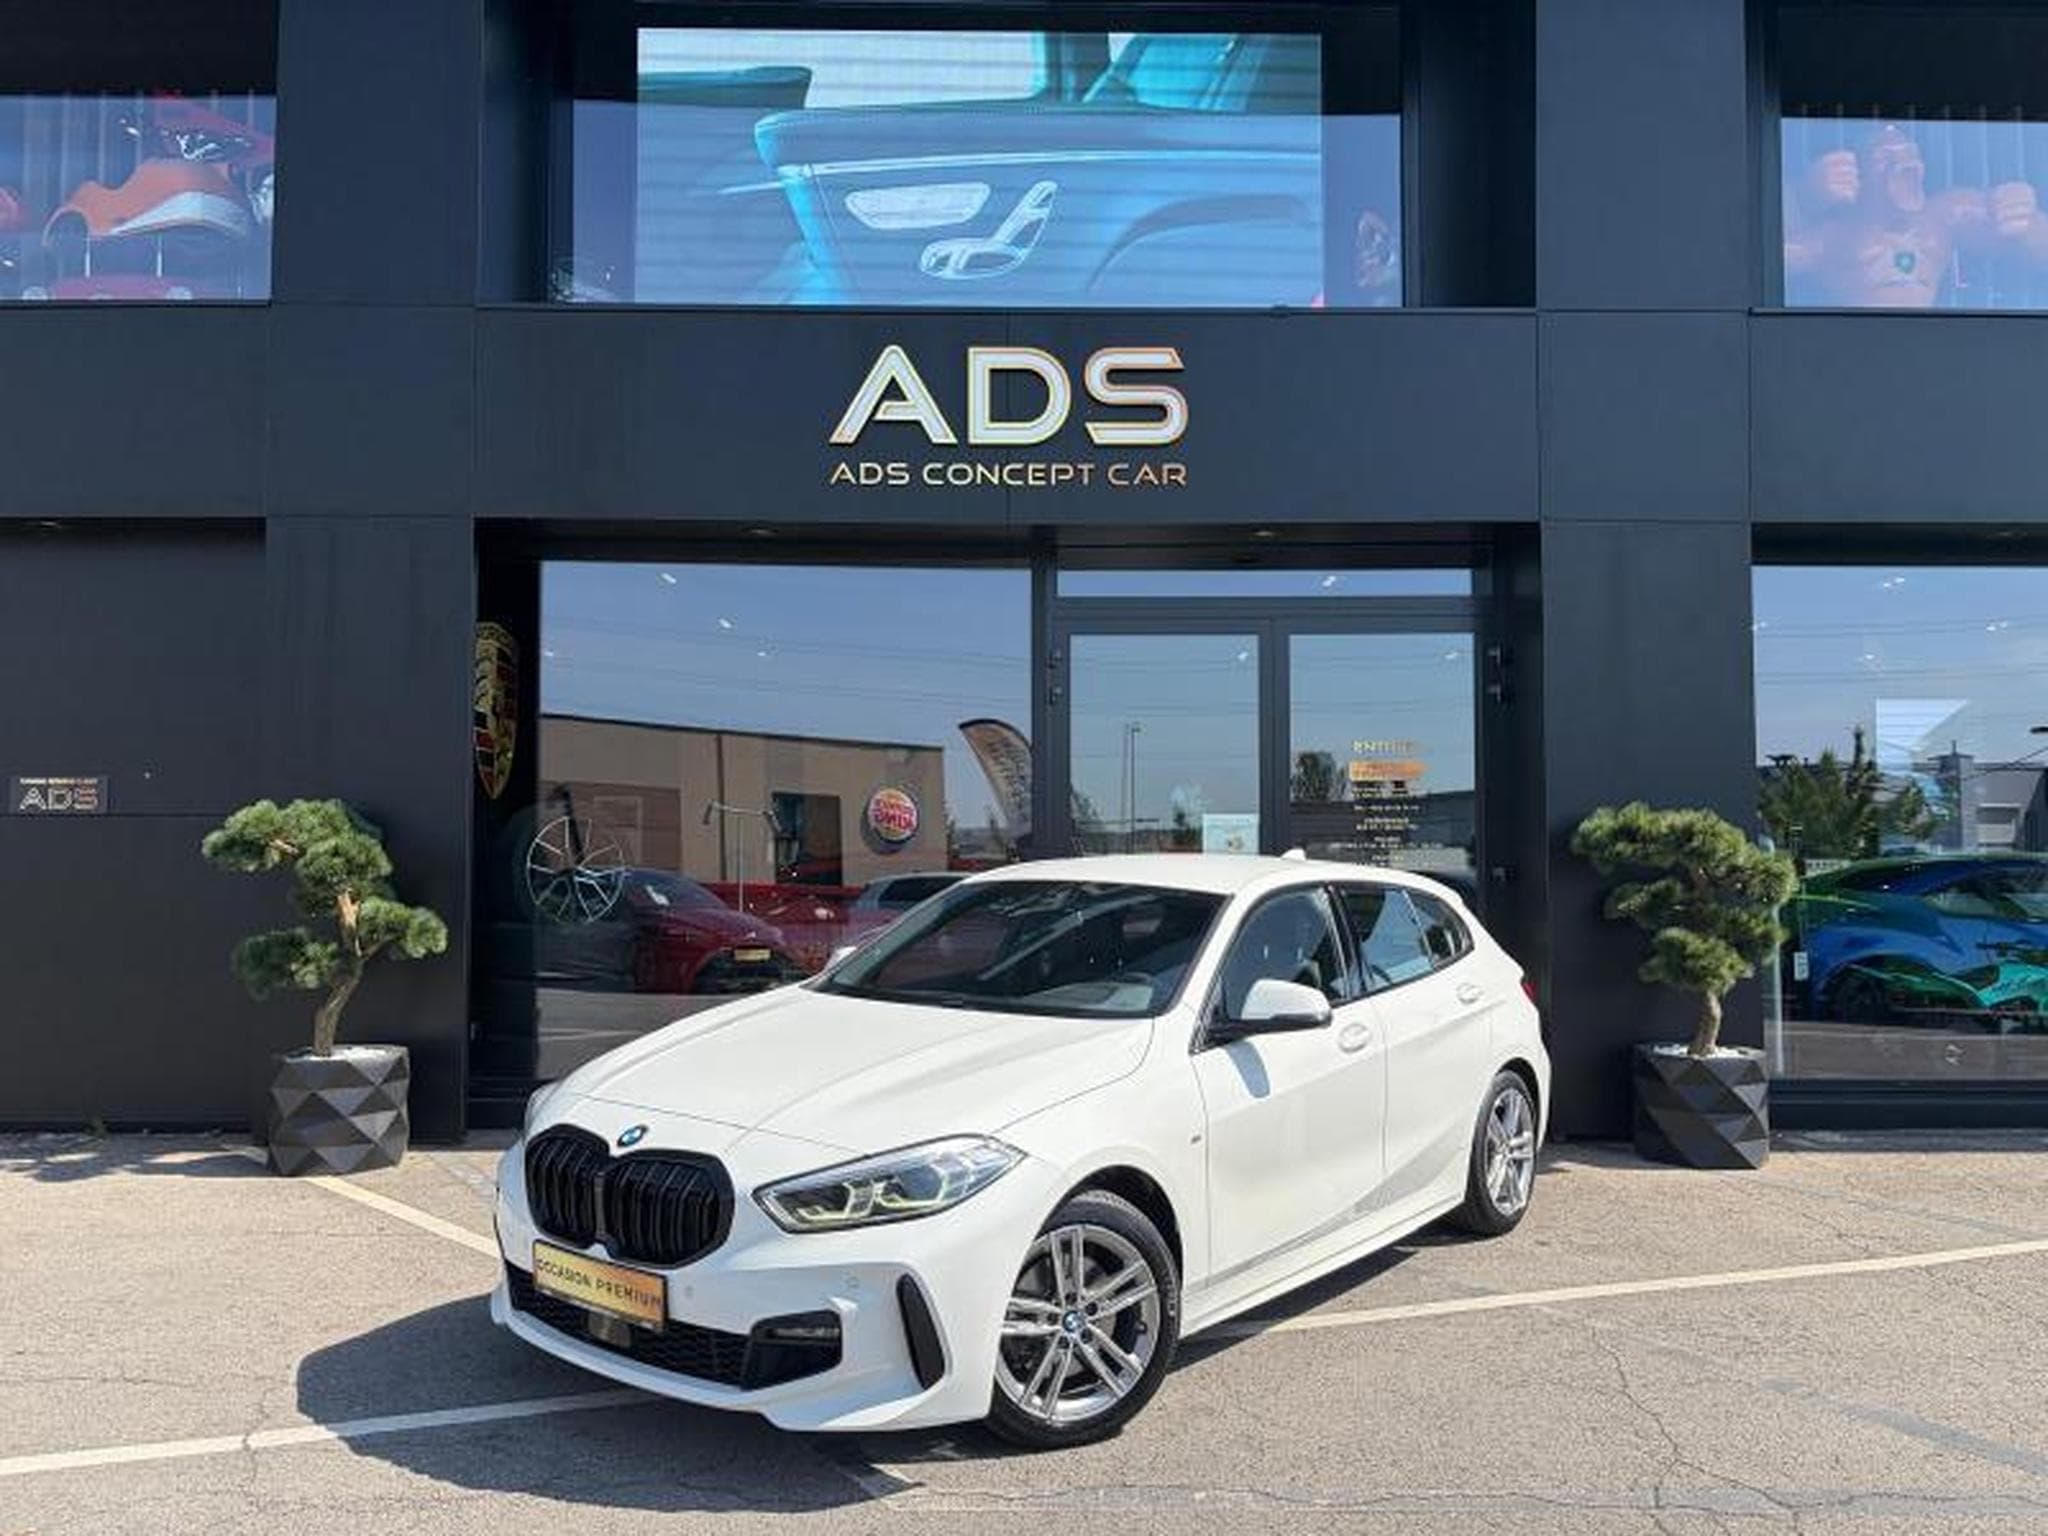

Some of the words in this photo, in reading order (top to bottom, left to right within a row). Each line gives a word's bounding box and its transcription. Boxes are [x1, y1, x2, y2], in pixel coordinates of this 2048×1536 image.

[829, 344, 1189, 445] ADS
[830, 461, 910, 485] ADS
[922, 461, 1095, 486] CONCEPT
[1107, 462, 1188, 486] CAR
[20, 786, 98, 810] ADS
[595, 1277, 662, 1308] PREMIUM
